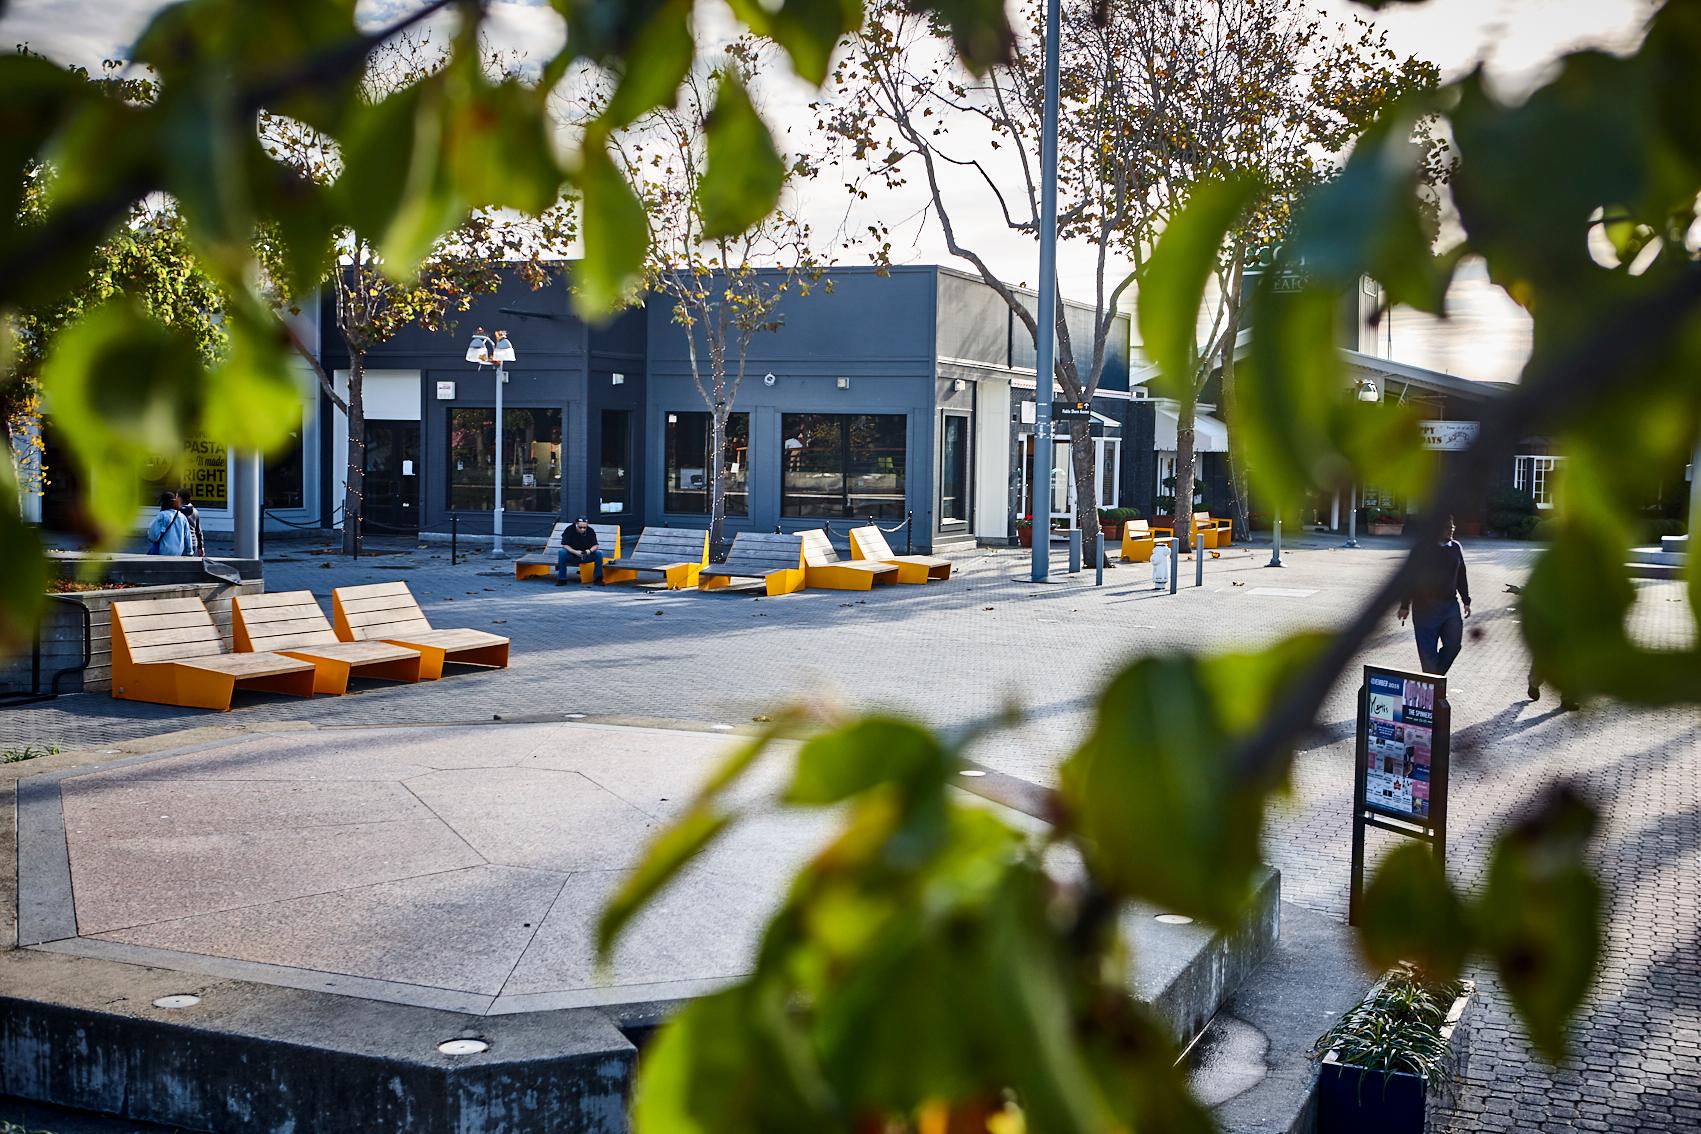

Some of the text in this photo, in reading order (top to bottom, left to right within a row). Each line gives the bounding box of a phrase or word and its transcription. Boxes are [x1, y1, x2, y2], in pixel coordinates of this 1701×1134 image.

[183, 440, 225, 454] PASTA
[183, 468, 225, 482] RIGHT
[183, 483, 225, 498] HERE
